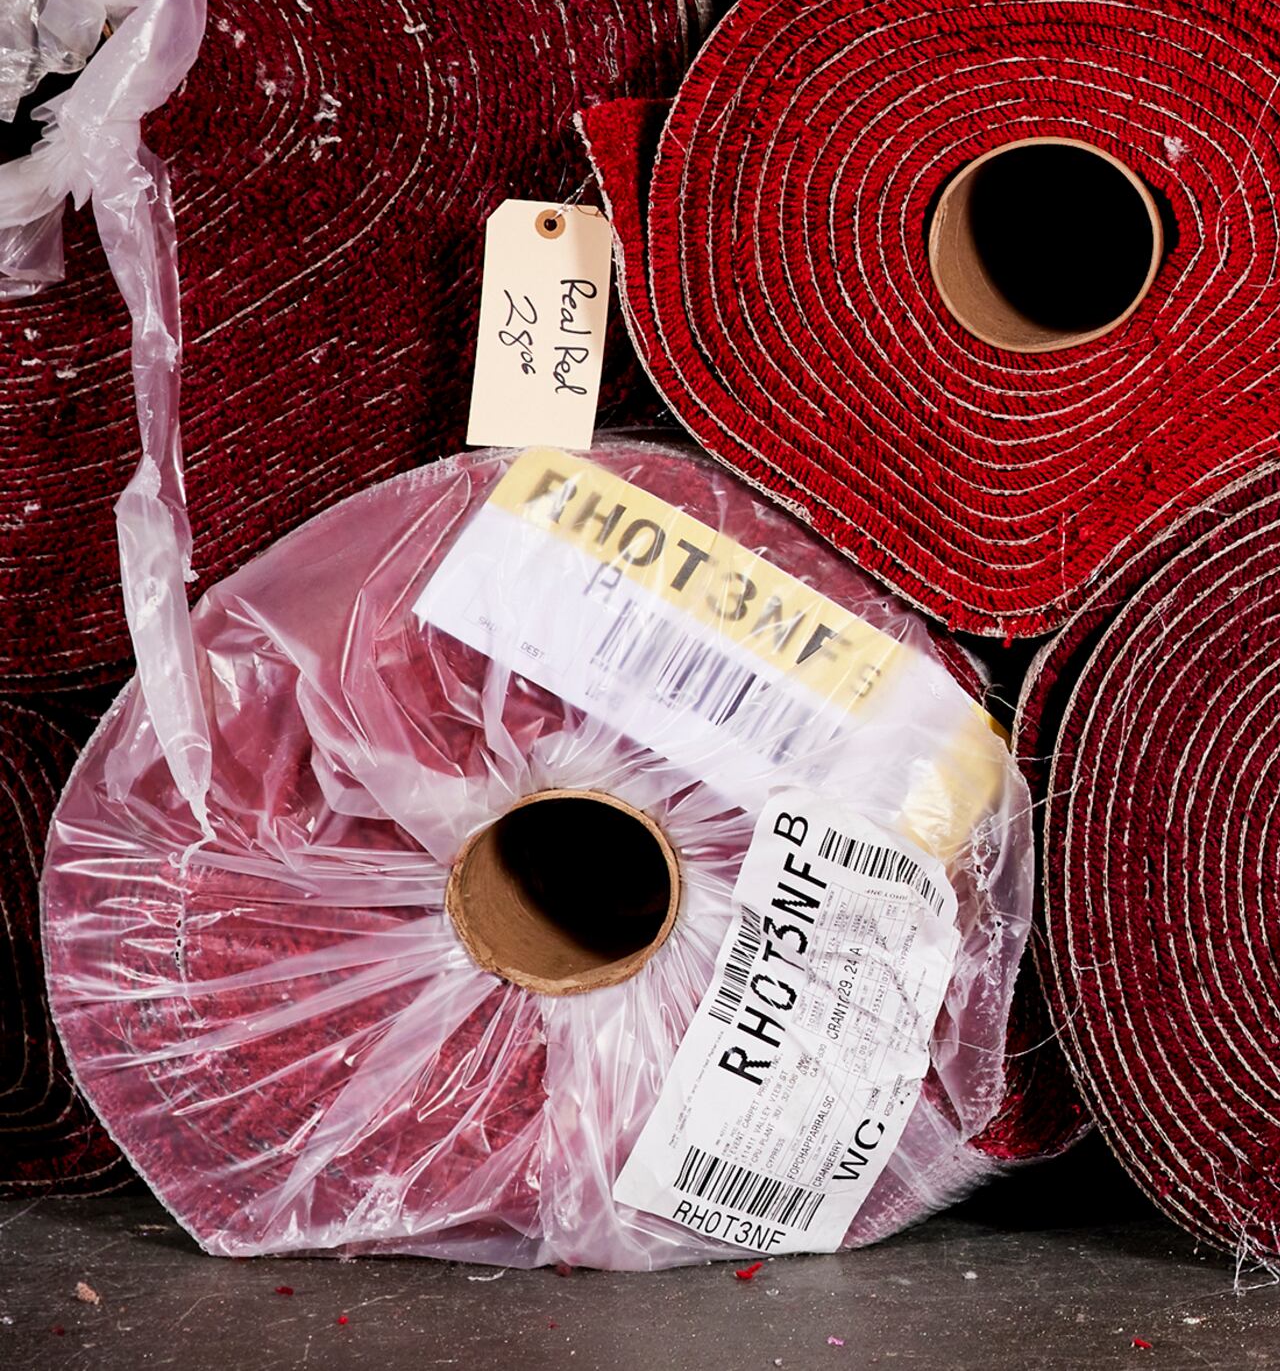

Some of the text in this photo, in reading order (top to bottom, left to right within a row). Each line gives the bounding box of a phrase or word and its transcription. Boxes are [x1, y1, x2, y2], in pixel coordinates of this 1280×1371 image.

[550, 278, 598, 395] Real Red
[773, 811, 809, 848] B
[848, 944, 863, 956] A
[808, 1066, 818, 1078] CA
[728, 1130, 745, 1155] EVENT
[741, 1099, 759, 1129] CARPET
[753, 1104, 772, 1134] VALLEY
[768, 1081, 782, 1103] VIEW
[778, 1069, 788, 1082] ST
[764, 1136, 785, 1170] CYPRESS
[786, 1094, 835, 1180] FOPCHAPPARRALSC
[811, 1138, 845, 1189] CRANBERRY
[831, 1118, 886, 1181] WC
